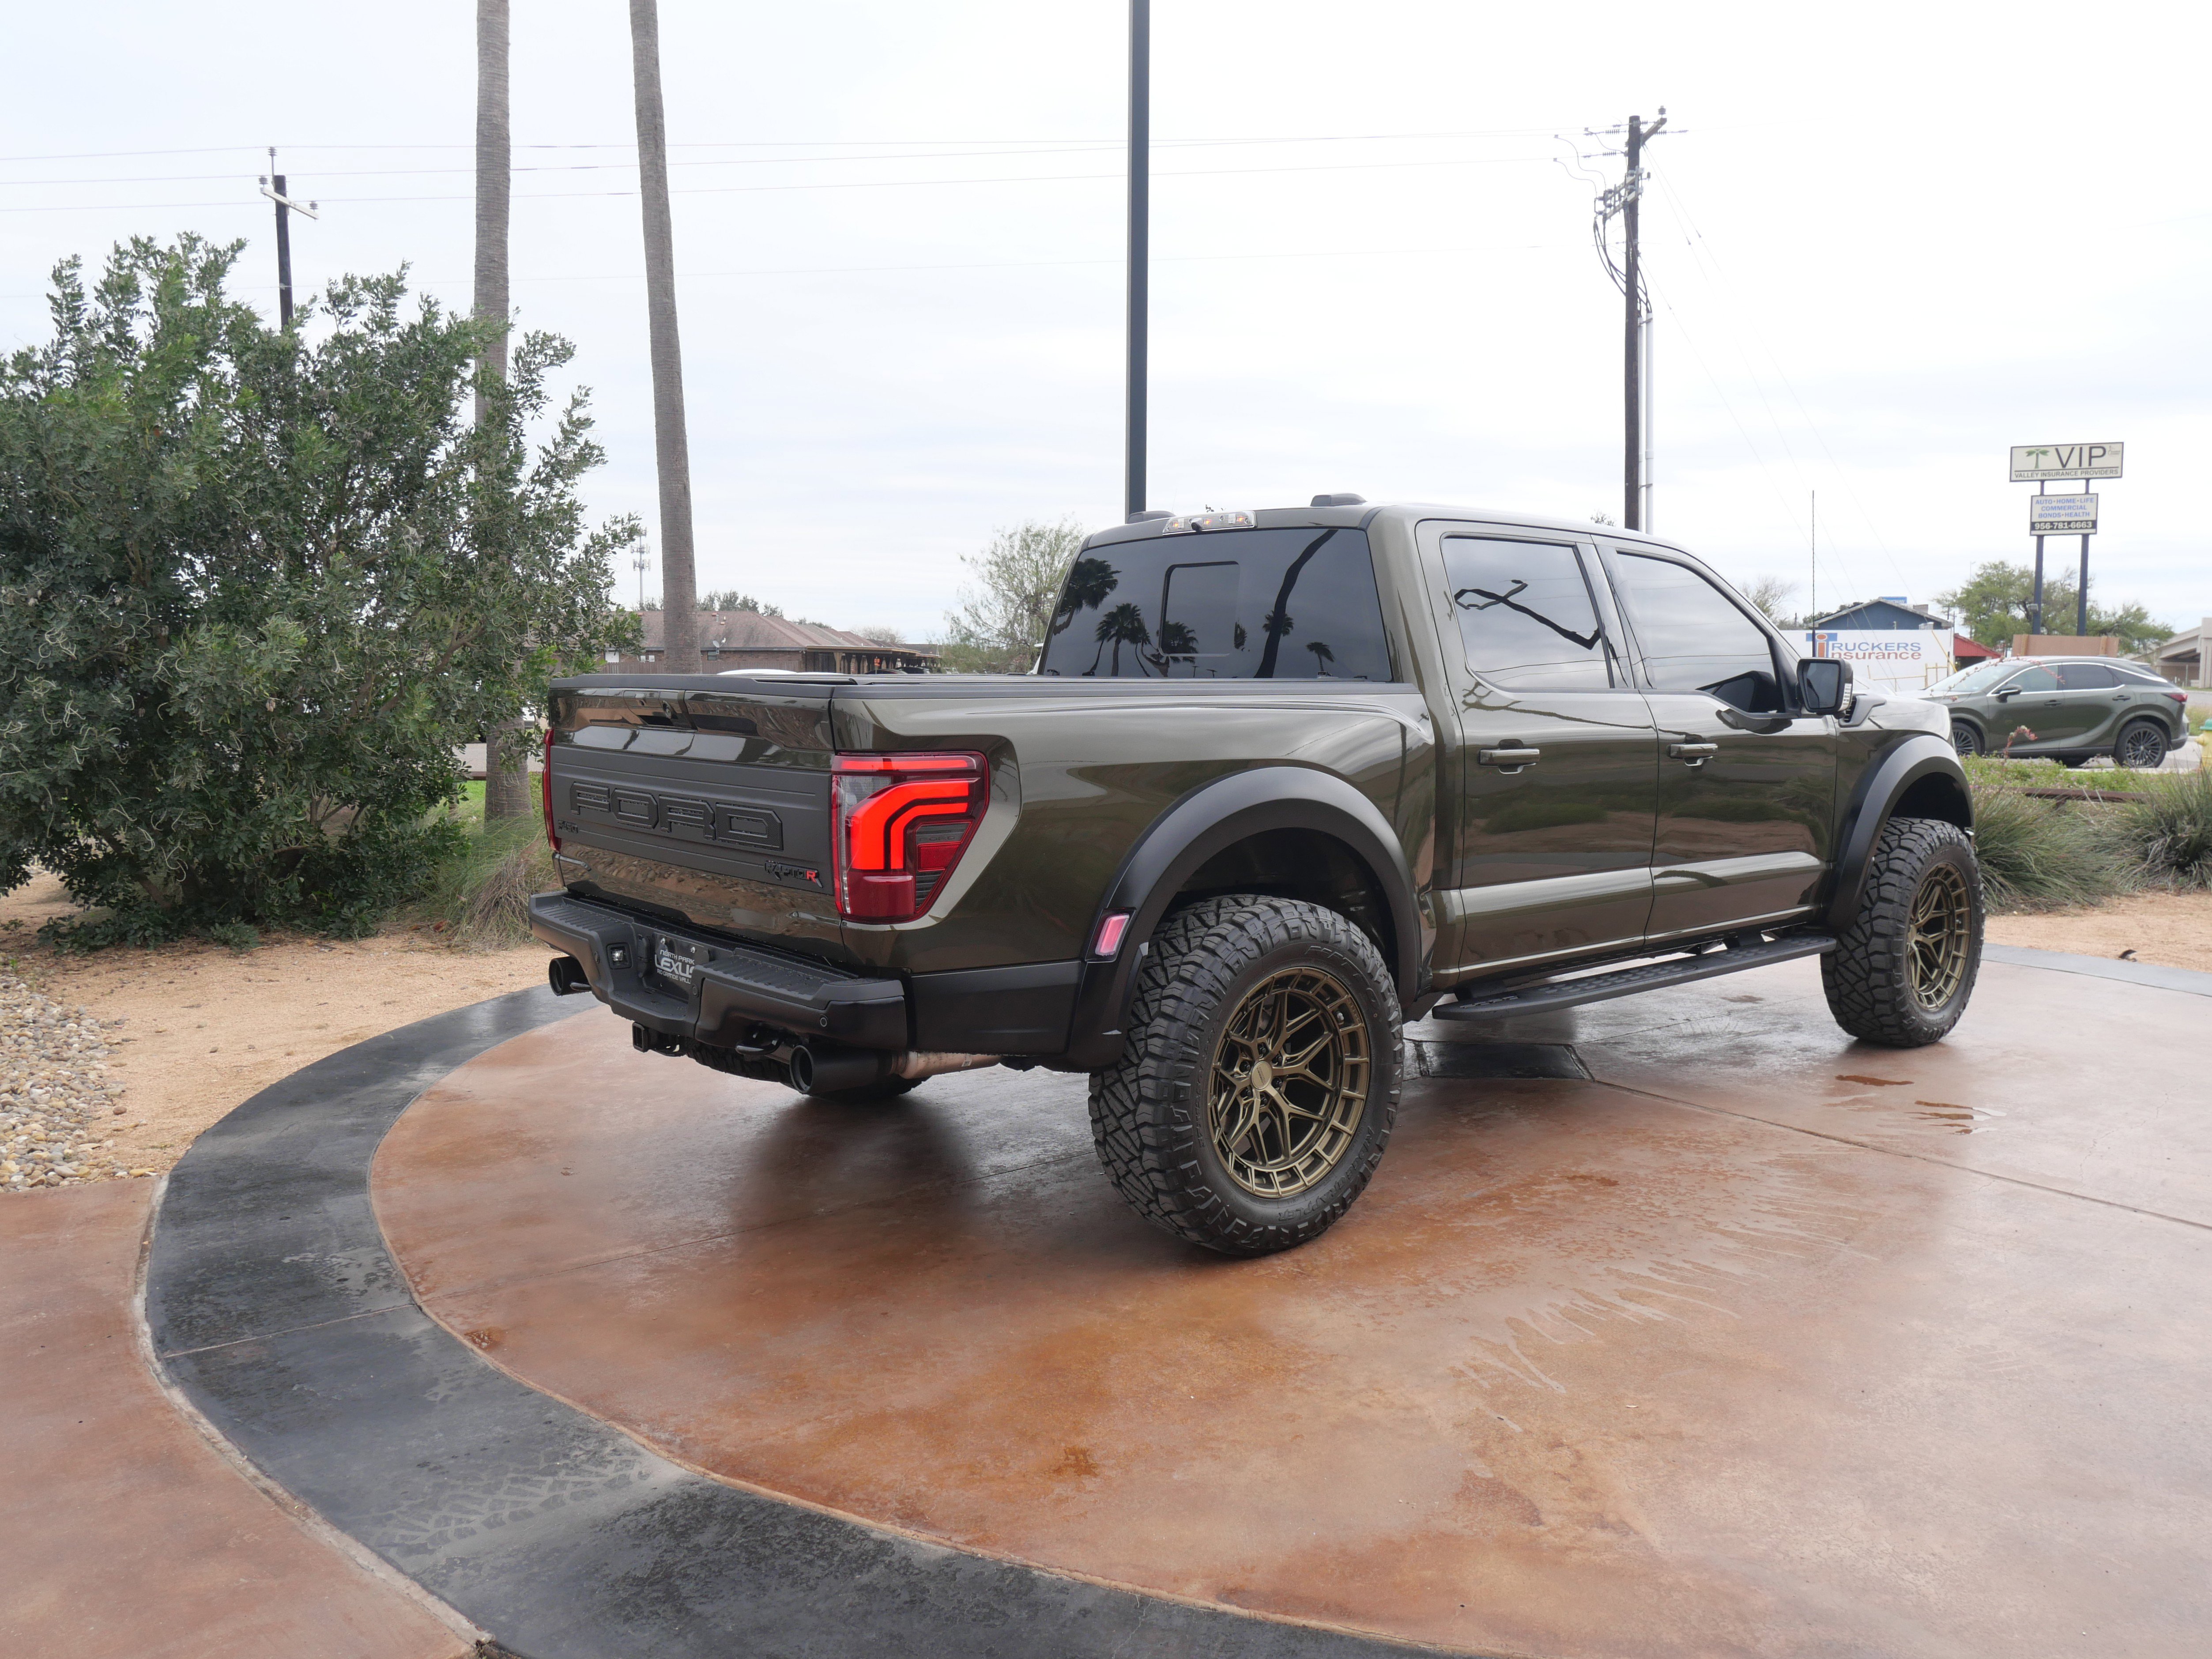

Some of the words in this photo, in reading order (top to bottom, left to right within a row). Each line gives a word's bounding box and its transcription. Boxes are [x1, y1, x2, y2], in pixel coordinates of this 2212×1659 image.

[2055, 446, 2106, 468] VIP
[2035, 521, 2092, 530] 956-781-6663
[570, 781, 784, 851] FORD
[660, 949, 678, 960] NORTH
[678, 955, 695, 965] PARK
[663, 971, 679, 980] GRANDE
